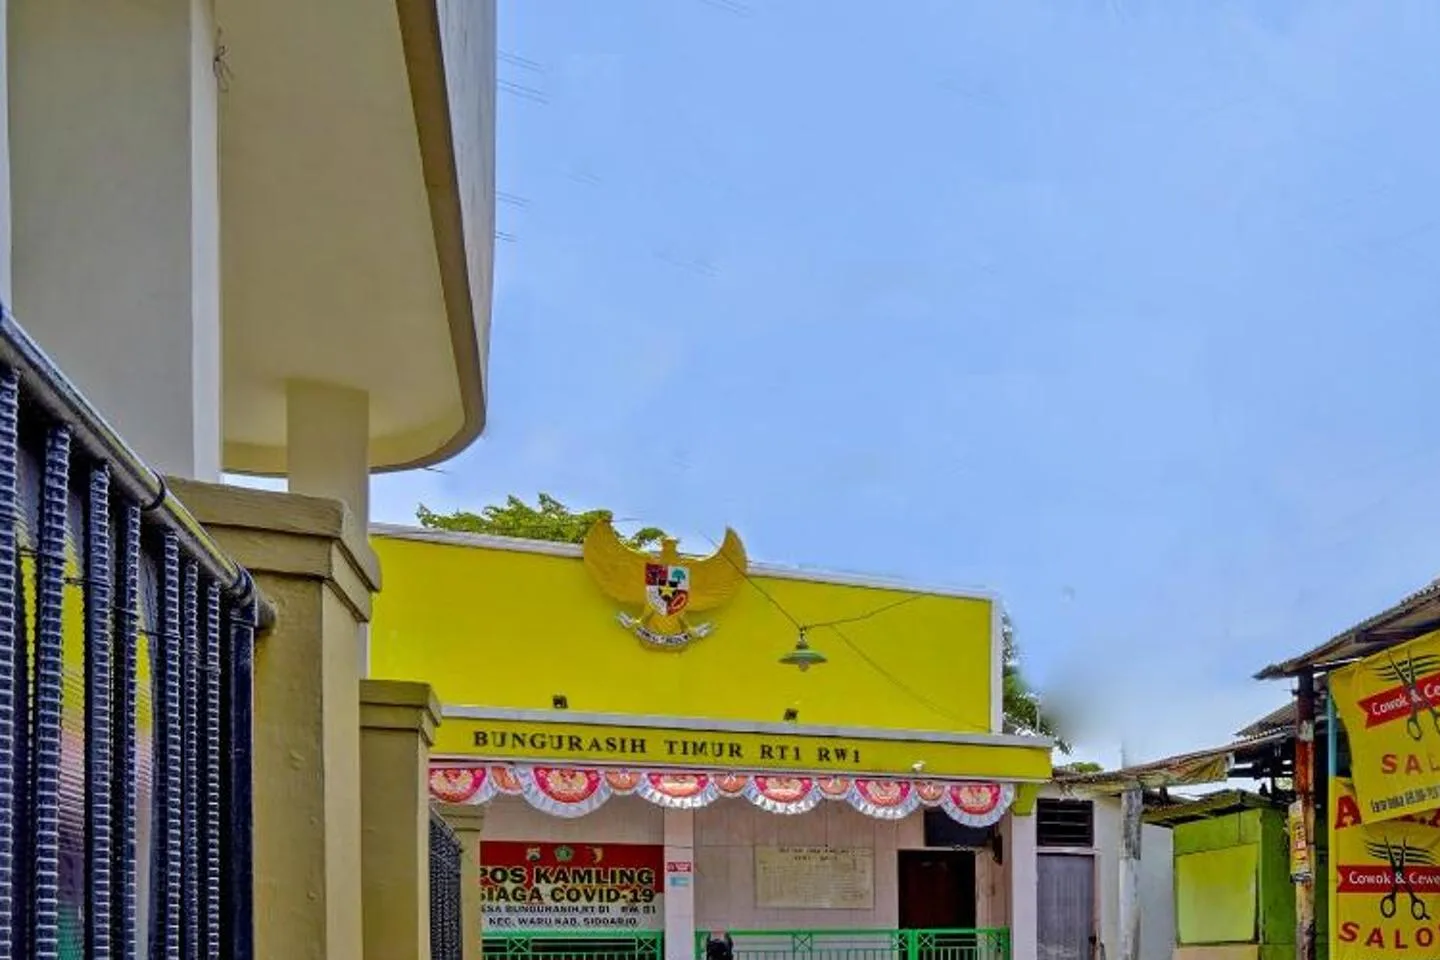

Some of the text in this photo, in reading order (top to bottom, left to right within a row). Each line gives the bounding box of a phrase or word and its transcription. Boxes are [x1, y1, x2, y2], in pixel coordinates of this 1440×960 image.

[1371, 694, 1409, 716] Cowok
[473, 731, 861, 763] BUNGURASIH TIMUR RT1 RW1
[535, 867, 653, 885] KAMLING
[1349, 871, 1391, 884] Cowok
[1395, 872, 1406, 884] &
[550, 887, 655, 903] COVID-19
